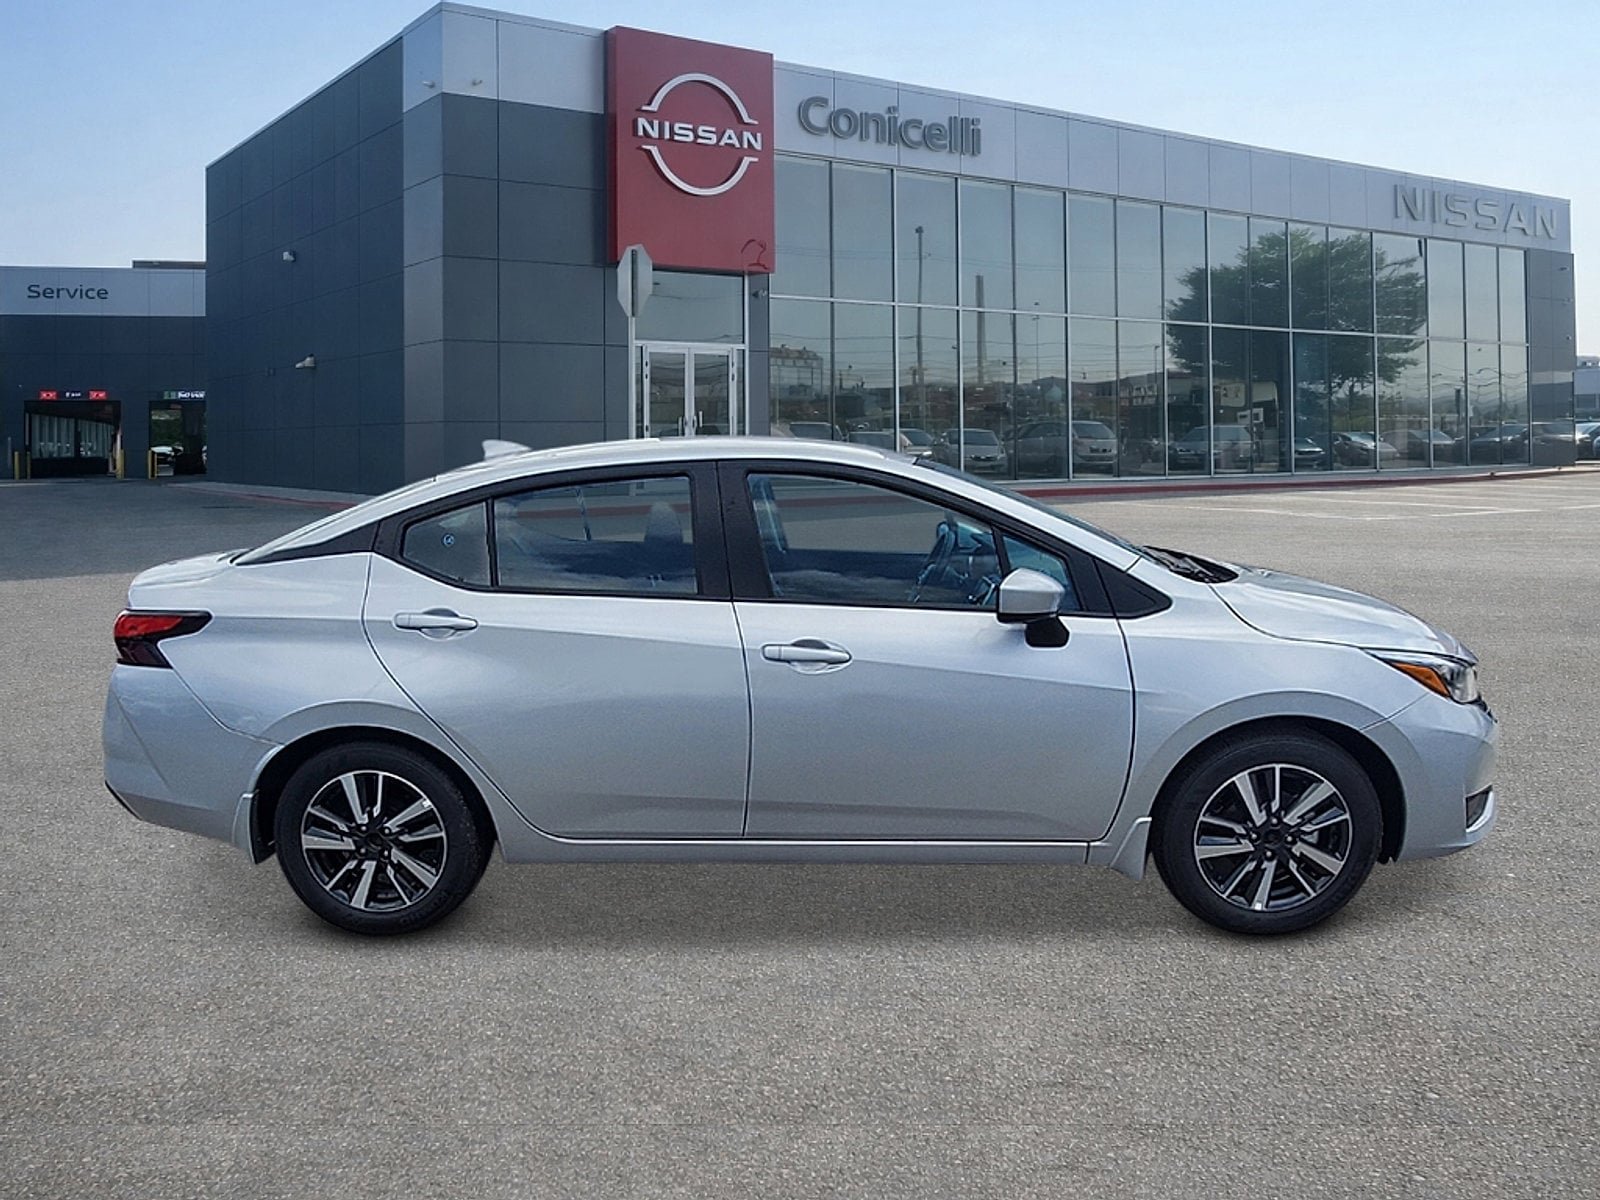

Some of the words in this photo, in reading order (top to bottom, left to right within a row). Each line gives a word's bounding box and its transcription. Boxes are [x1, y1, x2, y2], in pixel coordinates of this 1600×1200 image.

[636, 117, 763, 151] NISSAN
[799, 96, 982, 156] Conicelli
[1394, 184, 1557, 240] NISSAN
[27, 284, 109, 300] Service
